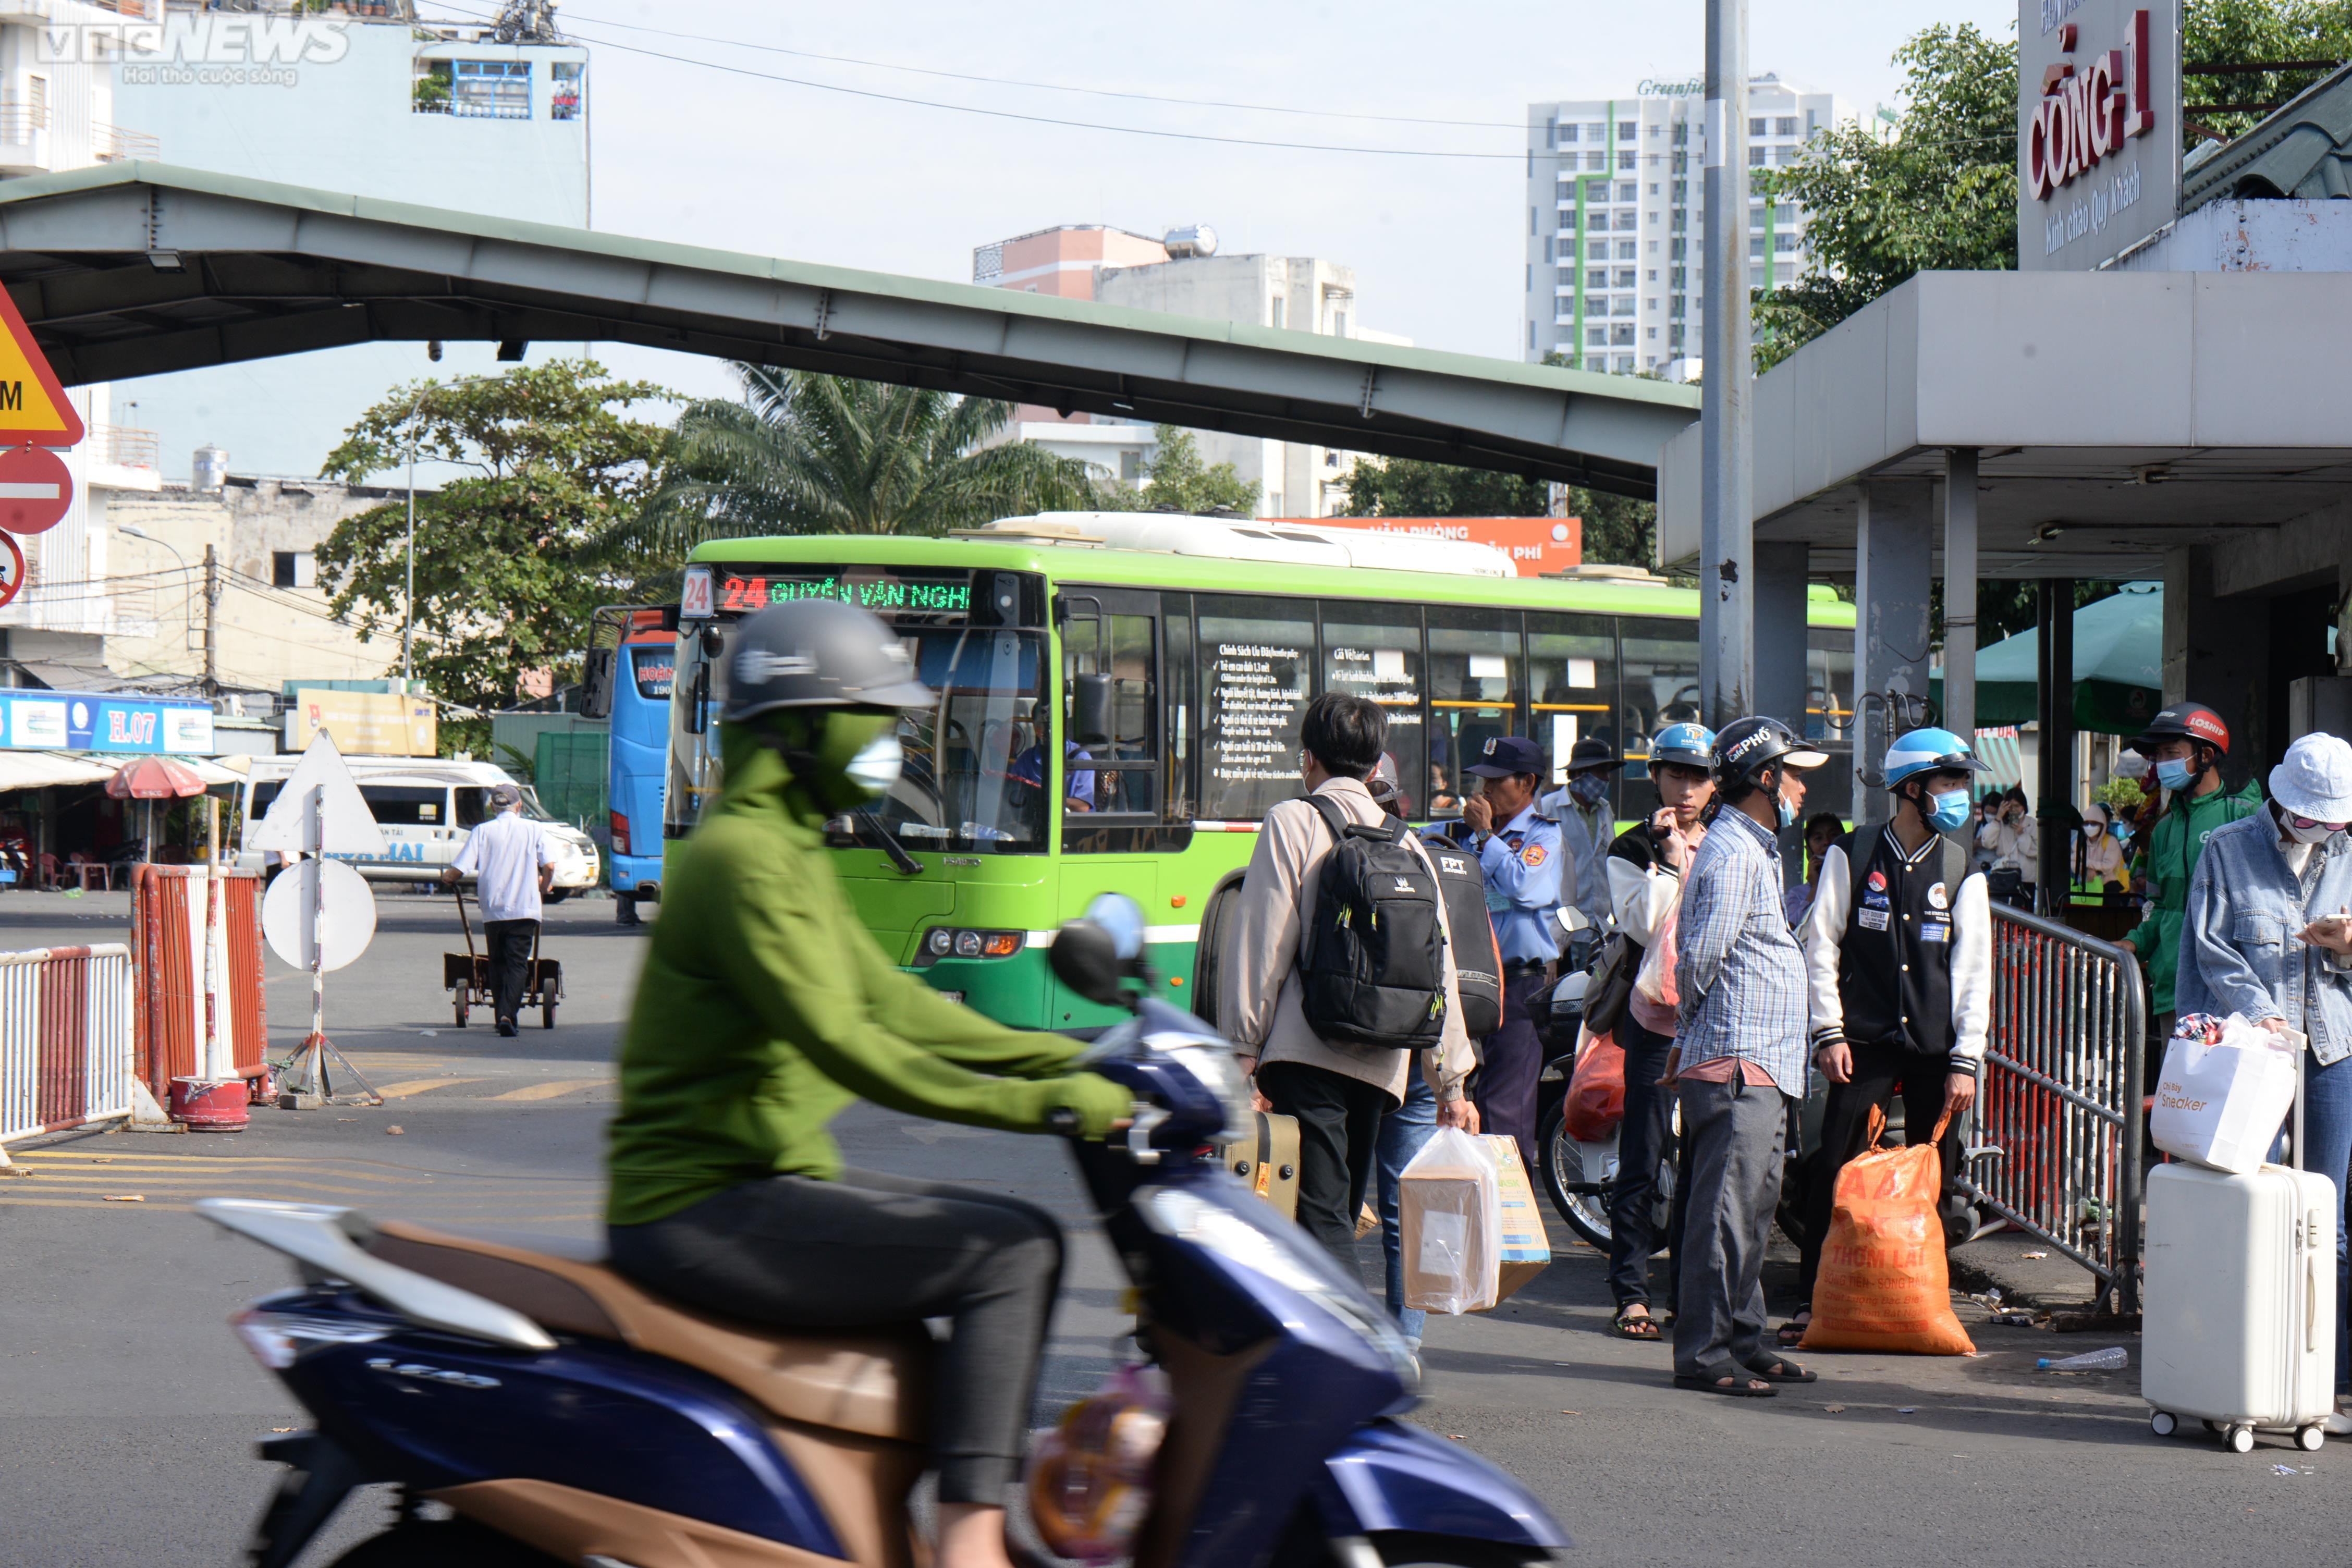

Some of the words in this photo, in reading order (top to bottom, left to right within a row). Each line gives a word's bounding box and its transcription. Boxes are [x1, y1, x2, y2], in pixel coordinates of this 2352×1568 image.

[2026, 23, 2126, 202] CỔNG
[2124, 9, 2154, 139] 1
[2046, 211, 2064, 256] Kính
[2067, 197, 2089, 242] chào
[2091, 181, 2109, 236] Quý
[2111, 160, 2141, 216] khách
[1514, 543, 1543, 560] PHÍ
[685, 577, 708, 609] 24
[724, 578, 768, 609] 24
[859, 581, 905, 607] VĂN
[108, 709, 156, 744] H.07
[2189, 717, 2227, 737] LOSHIP
[1440, 856, 1465, 870] FPT
[1870, 910, 1885, 919] DOUBT
[2162, 1094, 2208, 1112] Sneaker
[1833, 1244, 1885, 1268] THƠM
